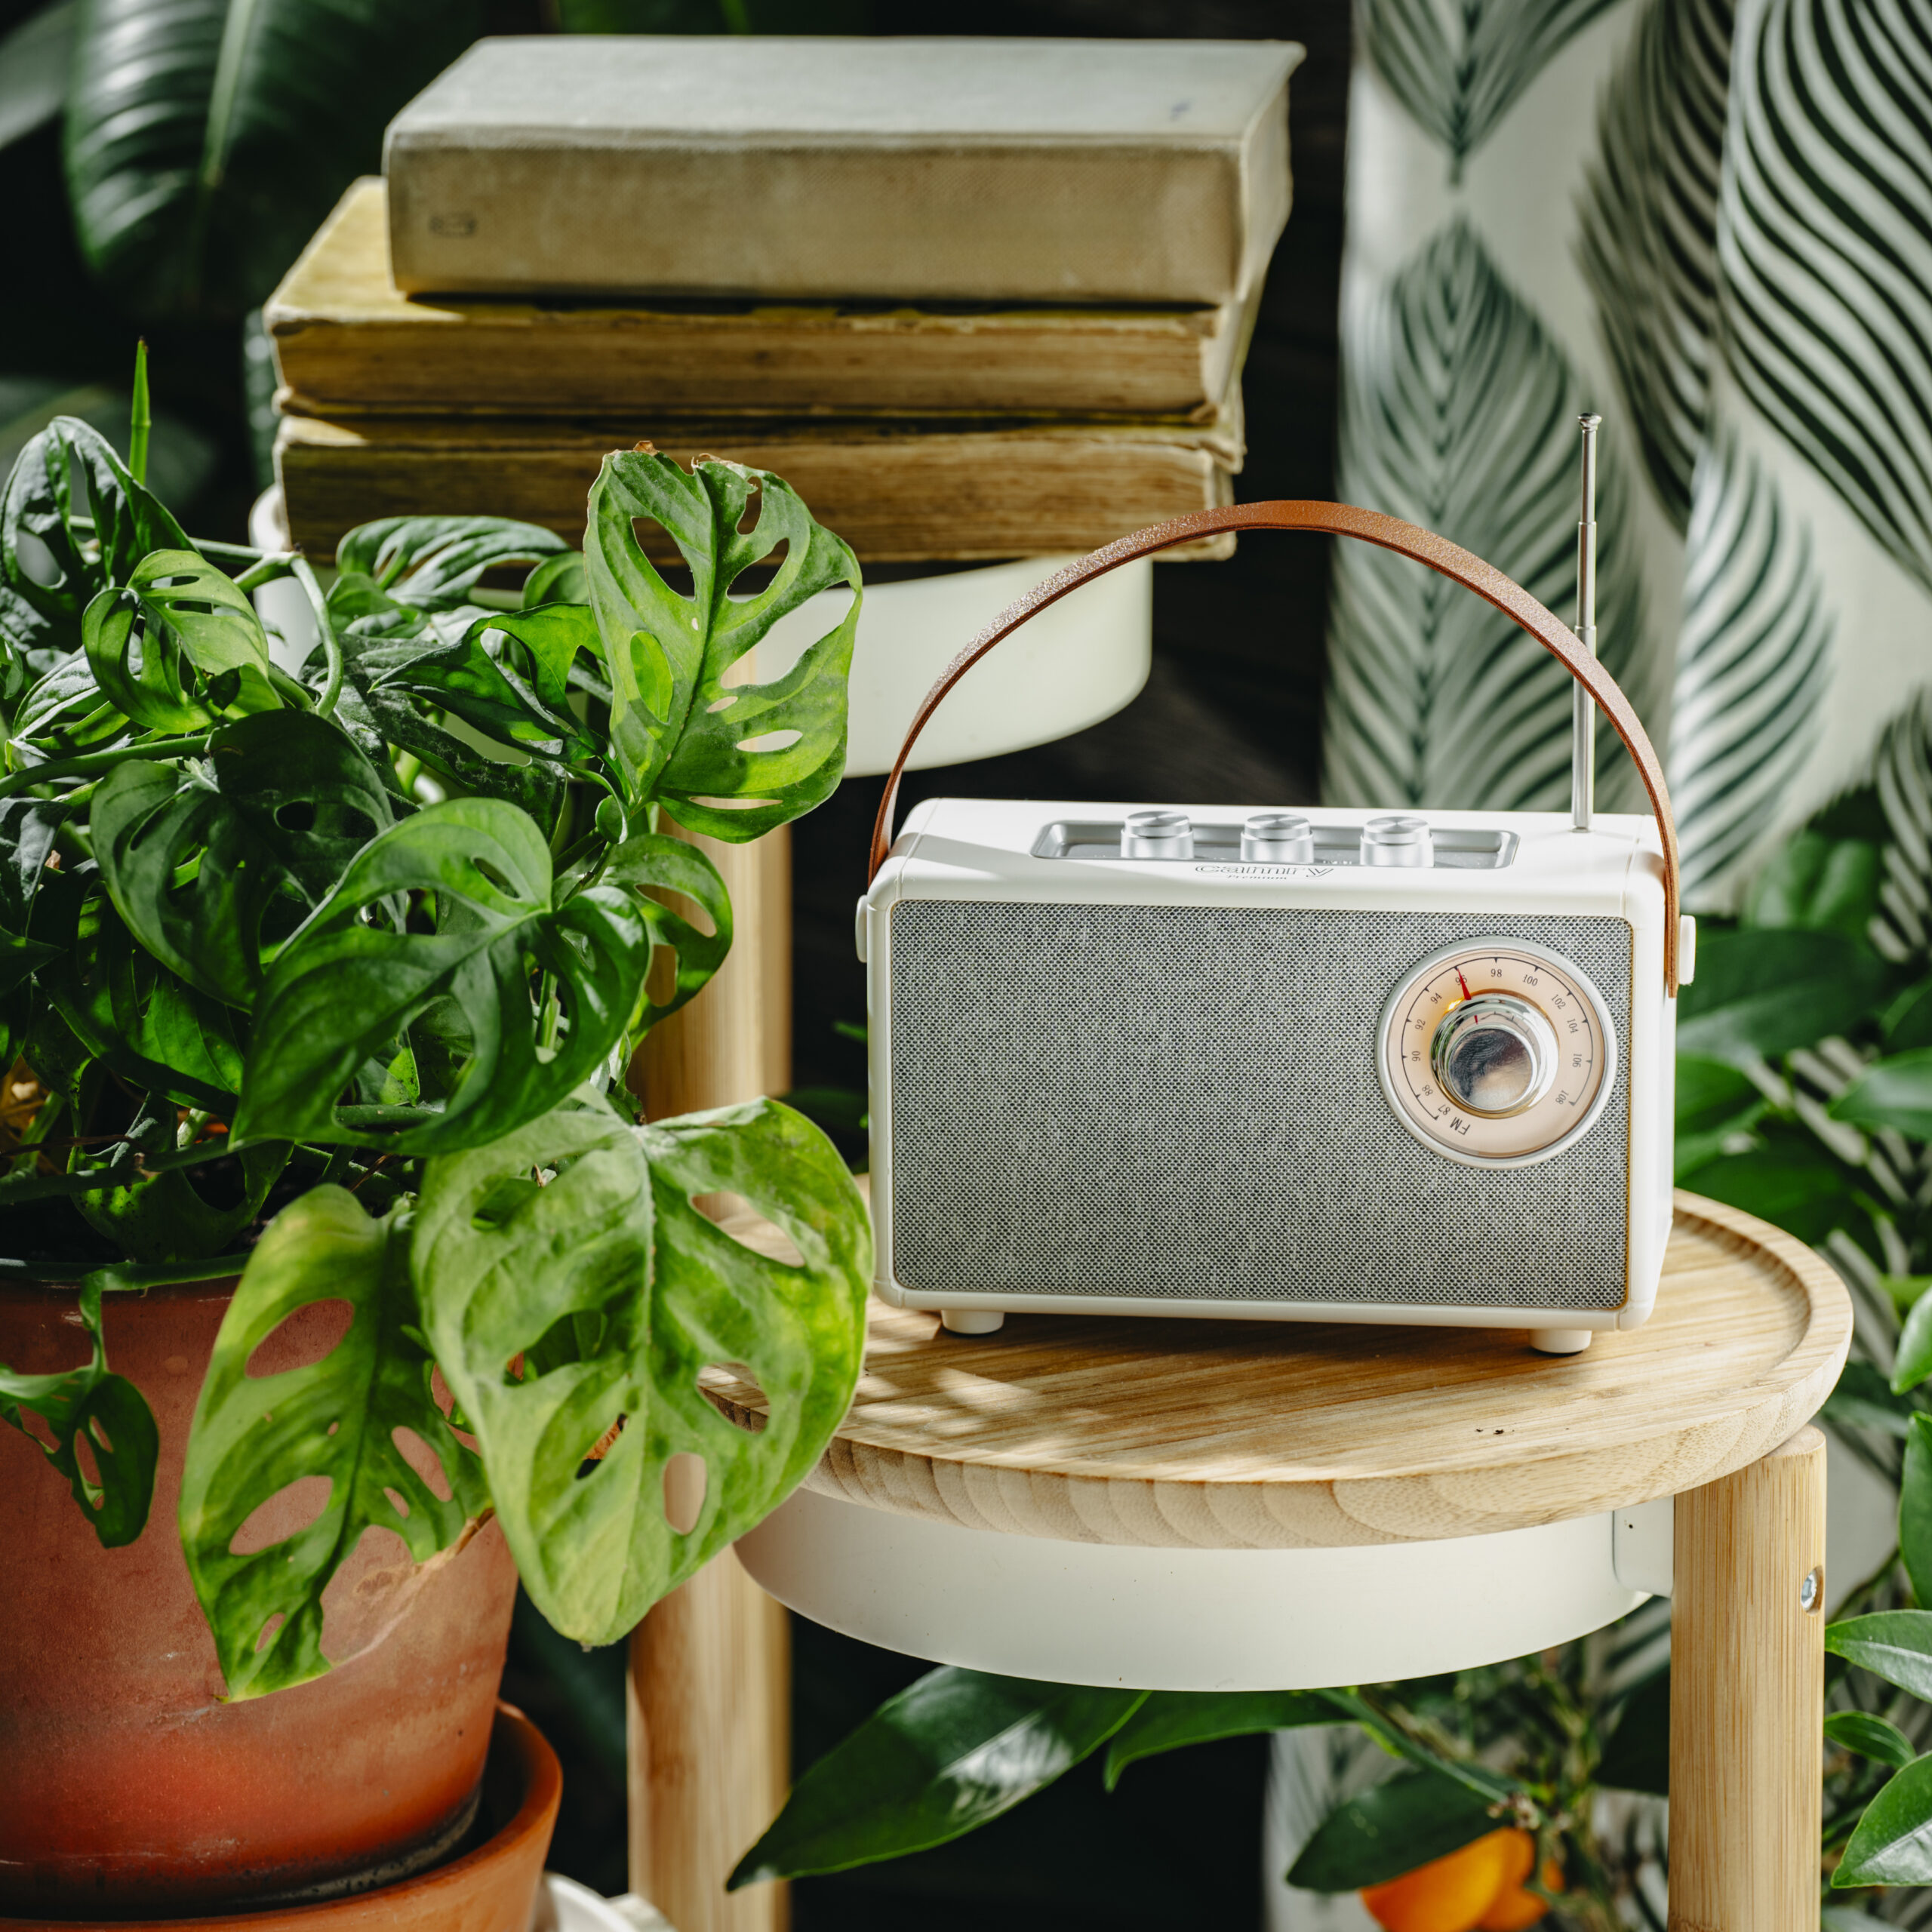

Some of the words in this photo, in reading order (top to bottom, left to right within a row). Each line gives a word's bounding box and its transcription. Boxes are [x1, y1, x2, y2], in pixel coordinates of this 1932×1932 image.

[1491, 969, 1502, 977] 98
[1523, 974, 1538, 986] 100
[1430, 992, 1442, 1004] 94
[1551, 994, 1566, 1010] 102
[1415, 1019, 1426, 1030] 92
[1567, 1018, 1579, 1034] 104
[1411, 1051, 1420, 1062] 90
[1573, 1053, 1582, 1068] 106
[1422, 1084, 1433, 1096] 88
[1555, 1090, 1569, 1105] 108
[1438, 1104, 1451, 1115] 87
[1450, 1117, 1471, 1135] FM
